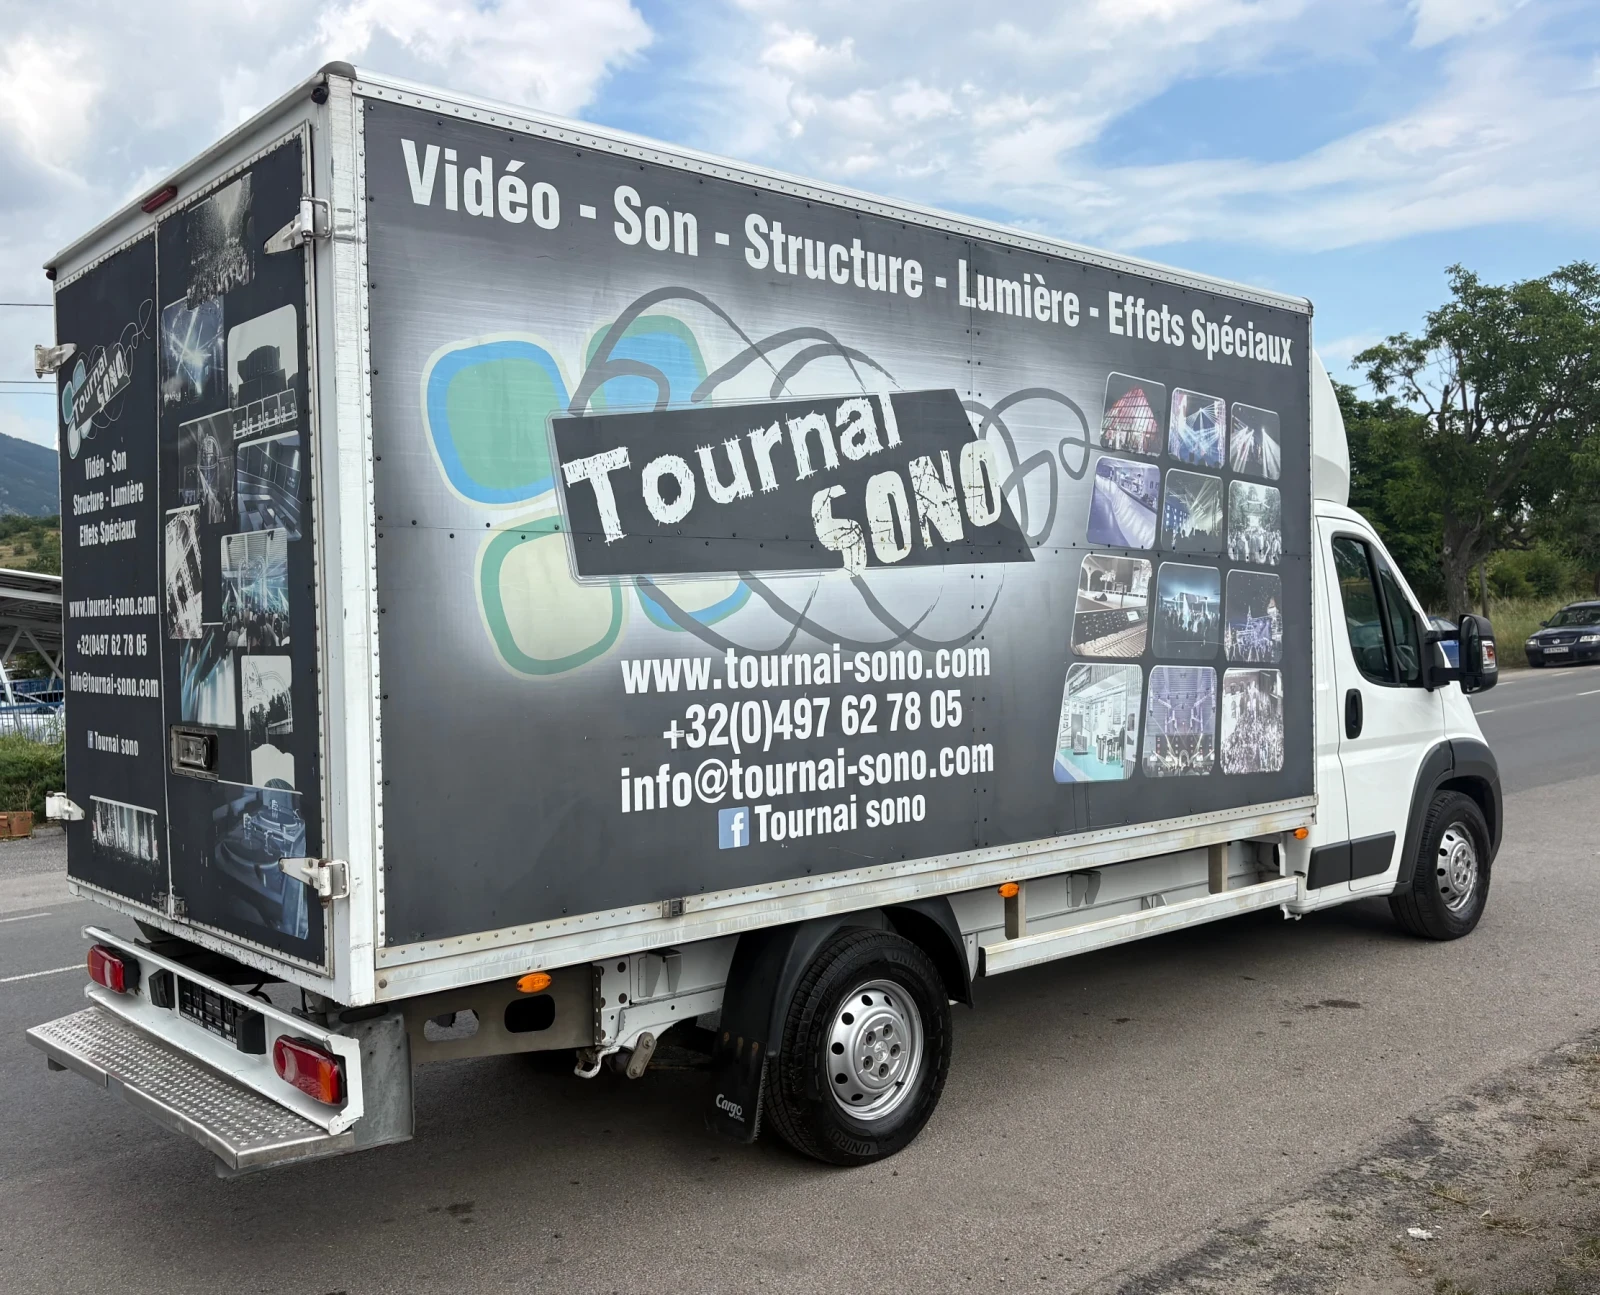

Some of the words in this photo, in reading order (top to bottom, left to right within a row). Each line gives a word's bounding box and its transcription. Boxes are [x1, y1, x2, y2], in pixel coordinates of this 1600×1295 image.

[400, 138, 561, 230] Vidéo
[613, 185, 698, 257] Son
[744, 213, 923, 299] Structure
[958, 259, 1080, 327] Lumière
[1108, 291, 1185, 347] Effets
[1191, 309, 1293, 367] Spéciaux
[84, 454, 105, 480] Vidéo
[111, 449, 127, 473] Son
[73, 490, 104, 516] Structure
[110, 480, 144, 508] Lumière
[811, 438, 1001, 577] SONO
[100, 518, 137, 546] Spéciaux
[69, 594, 157, 618] www.tournai-sono.com
[111, 633, 121, 656] 62
[123, 633, 134, 656] 78
[136, 633, 147, 656] 05
[620, 643, 991, 694] www.tournai-sono.com
[662, 696, 831, 755] +32(0)497
[841, 693, 878, 736] 62
[886, 691, 922, 732] 78
[929, 689, 963, 728] 05
[94, 731, 119, 754] Tournai
[120, 738, 139, 757] sono
[620, 742, 994, 814] info@tournai-sono.com
[754, 794, 858, 843] Tournai
[865, 793, 926, 827] sono
[715, 1093, 743, 1118] Cargo
